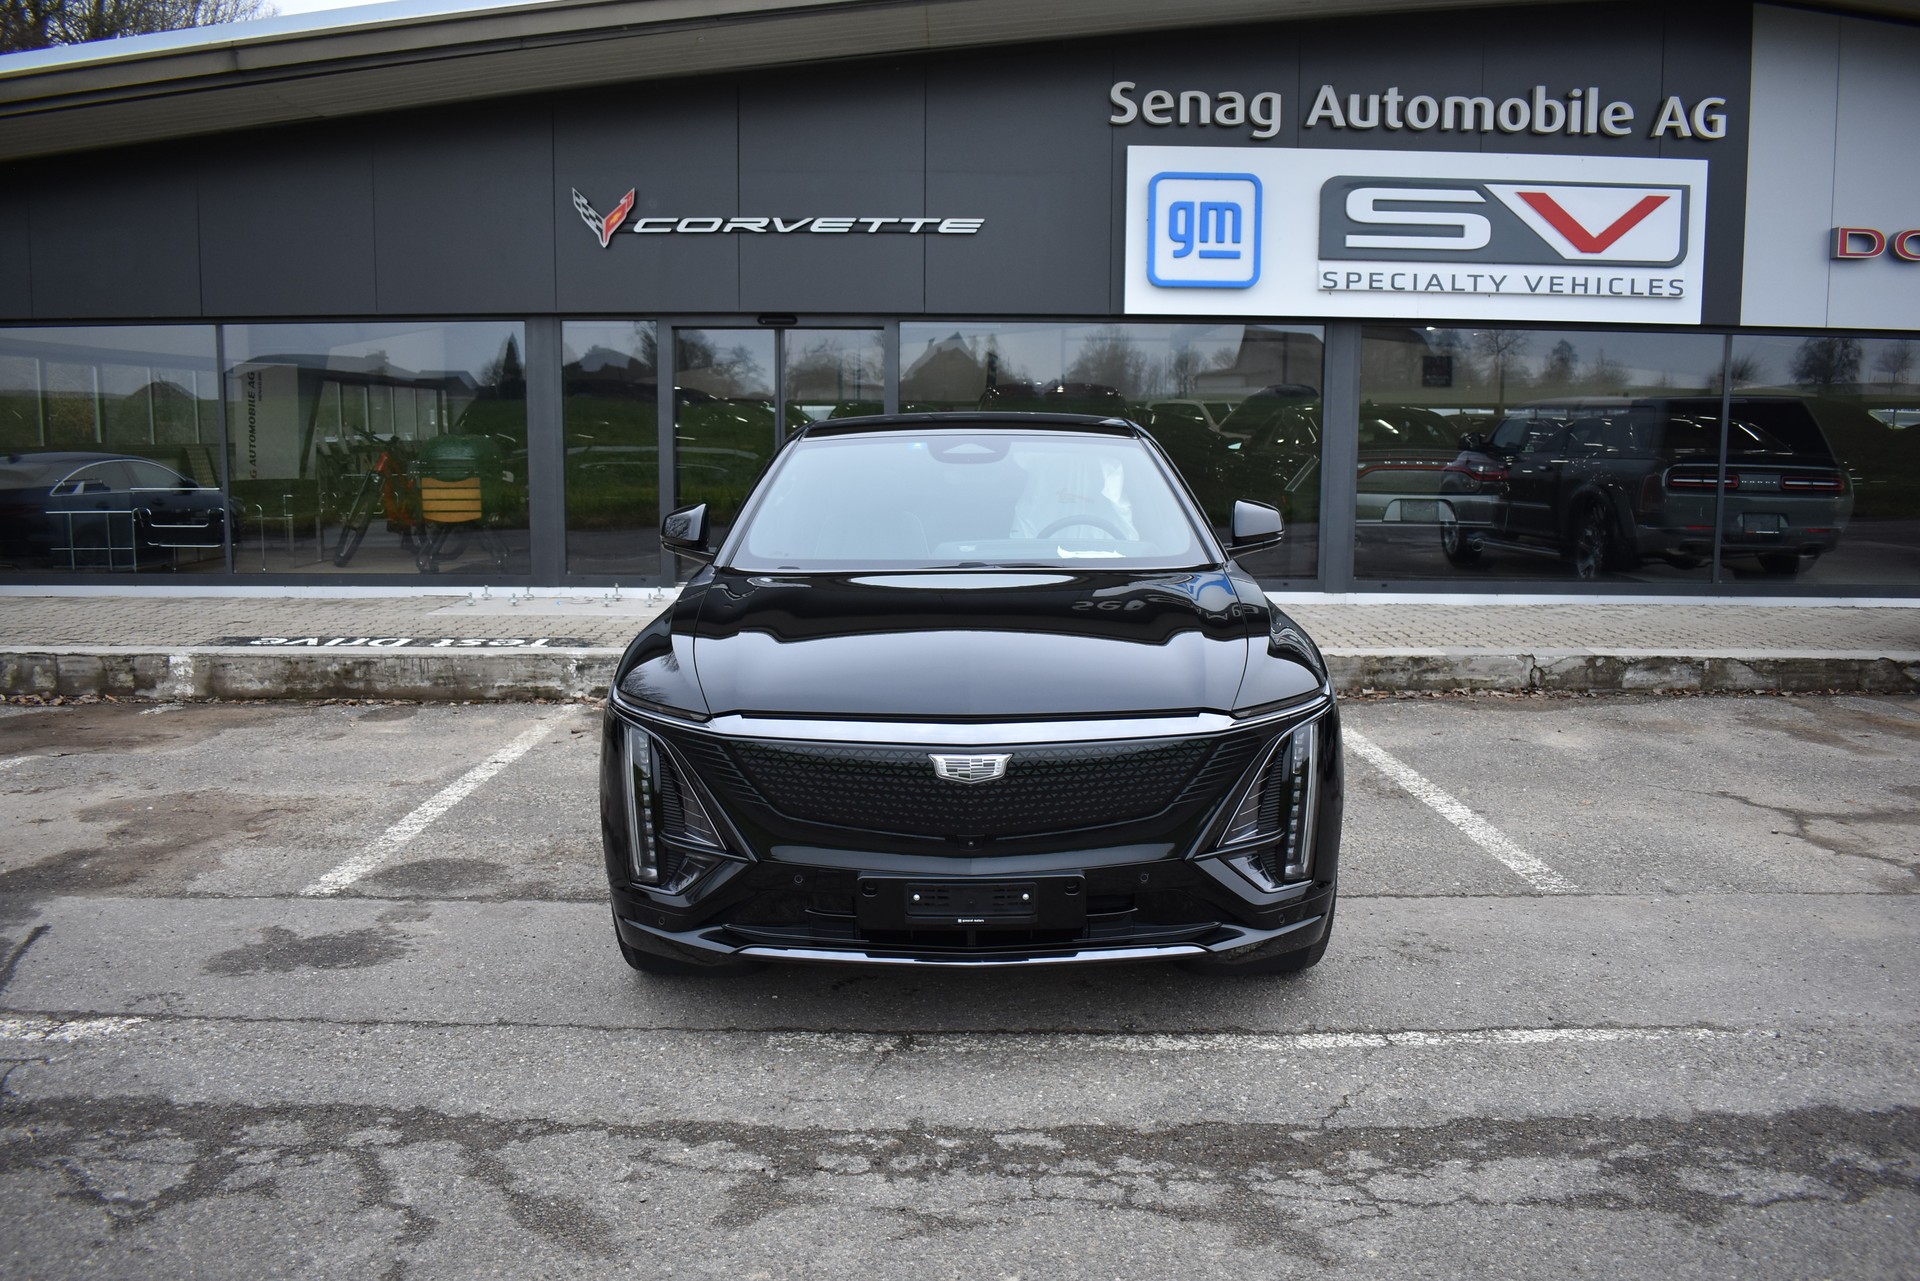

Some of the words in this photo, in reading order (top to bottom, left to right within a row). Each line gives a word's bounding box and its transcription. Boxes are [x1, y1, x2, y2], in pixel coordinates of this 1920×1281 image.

[1109, 81, 1282, 138] Senag
[1305, 84, 1635, 138] Automobile
[1650, 96, 1727, 140] AG
[633, 217, 986, 234] CORVETTE
[1168, 201, 1242, 259] gm
[1322, 271, 1508, 293] SPECIALTY
[1524, 275, 1685, 297] VEHICLES
[247, 371, 256, 389] AG
[247, 391, 257, 467] AUTOMOBILE
[429, 637, 550, 648] Test
